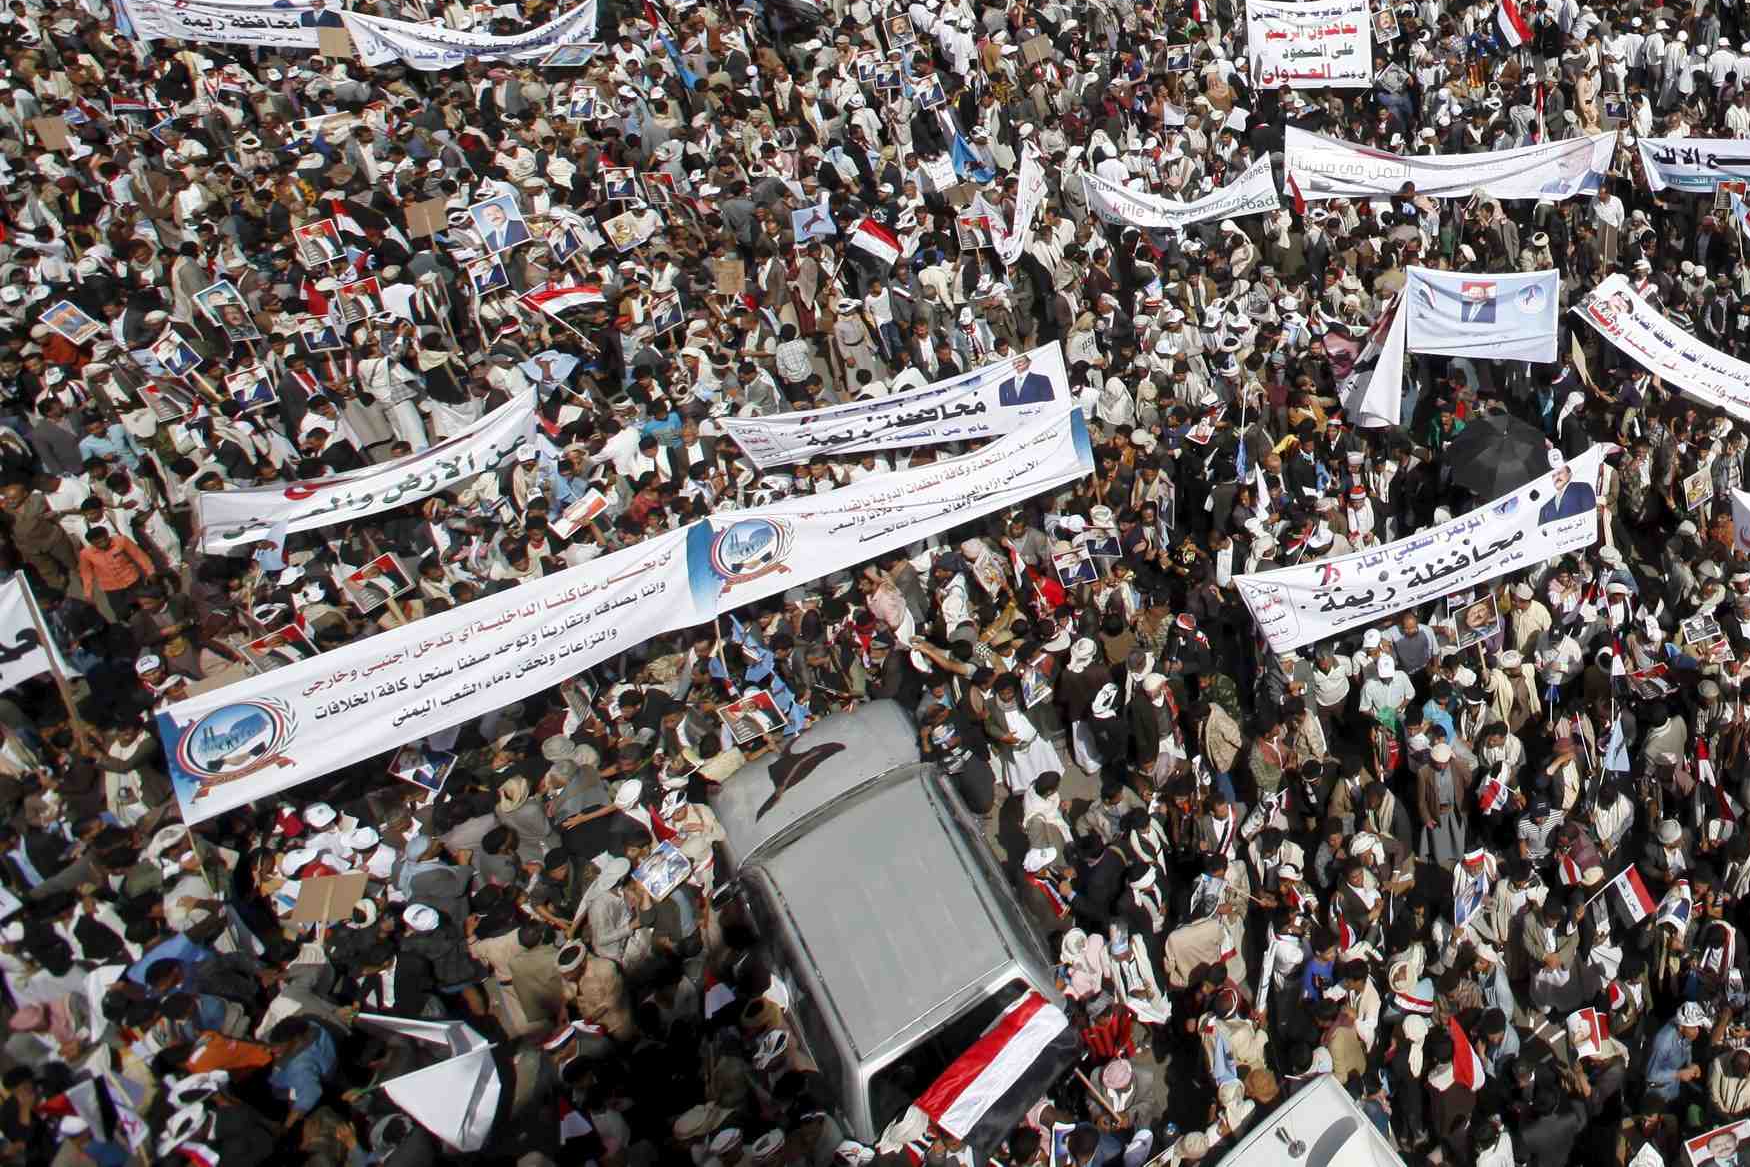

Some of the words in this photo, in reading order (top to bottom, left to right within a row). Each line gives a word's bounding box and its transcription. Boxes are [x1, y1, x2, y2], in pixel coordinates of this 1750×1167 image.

[1281, 42, 1328, 63] الصمود
[1330, 41, 1355, 60] على
[1261, 63, 1332, 86] العدوان
[1651, 145, 1677, 165] لله
[1679, 146, 1702, 172] إلا
[882, 398, 988, 431] محافظة
[967, 421, 991, 435] عام
[1446, 512, 1487, 542] المؤتمر
[1392, 532, 1446, 564] الشعبي
[1401, 527, 1526, 590] محافظة
[1353, 550, 1392, 576] العام
[543, 582, 600, 610] مشاكلنا
[1310, 580, 1397, 615] ريمة
[476, 601, 542, 635] الداخلية
[413, 631, 454, 659] تدخل
[557, 626, 619, 659] والنزاعات
[361, 649, 409, 678] اجنبي
[457, 652, 491, 672] صفنا
[514, 652, 557, 679] ونحقن
[302, 668, 358, 698] وخارجي
[378, 676, 410, 699] كافة
[413, 664, 454, 691] سنحل
[314, 690, 376, 722] الخلافات
[439, 681, 483, 707] الشعب
[390, 696, 438, 729] اليمني
